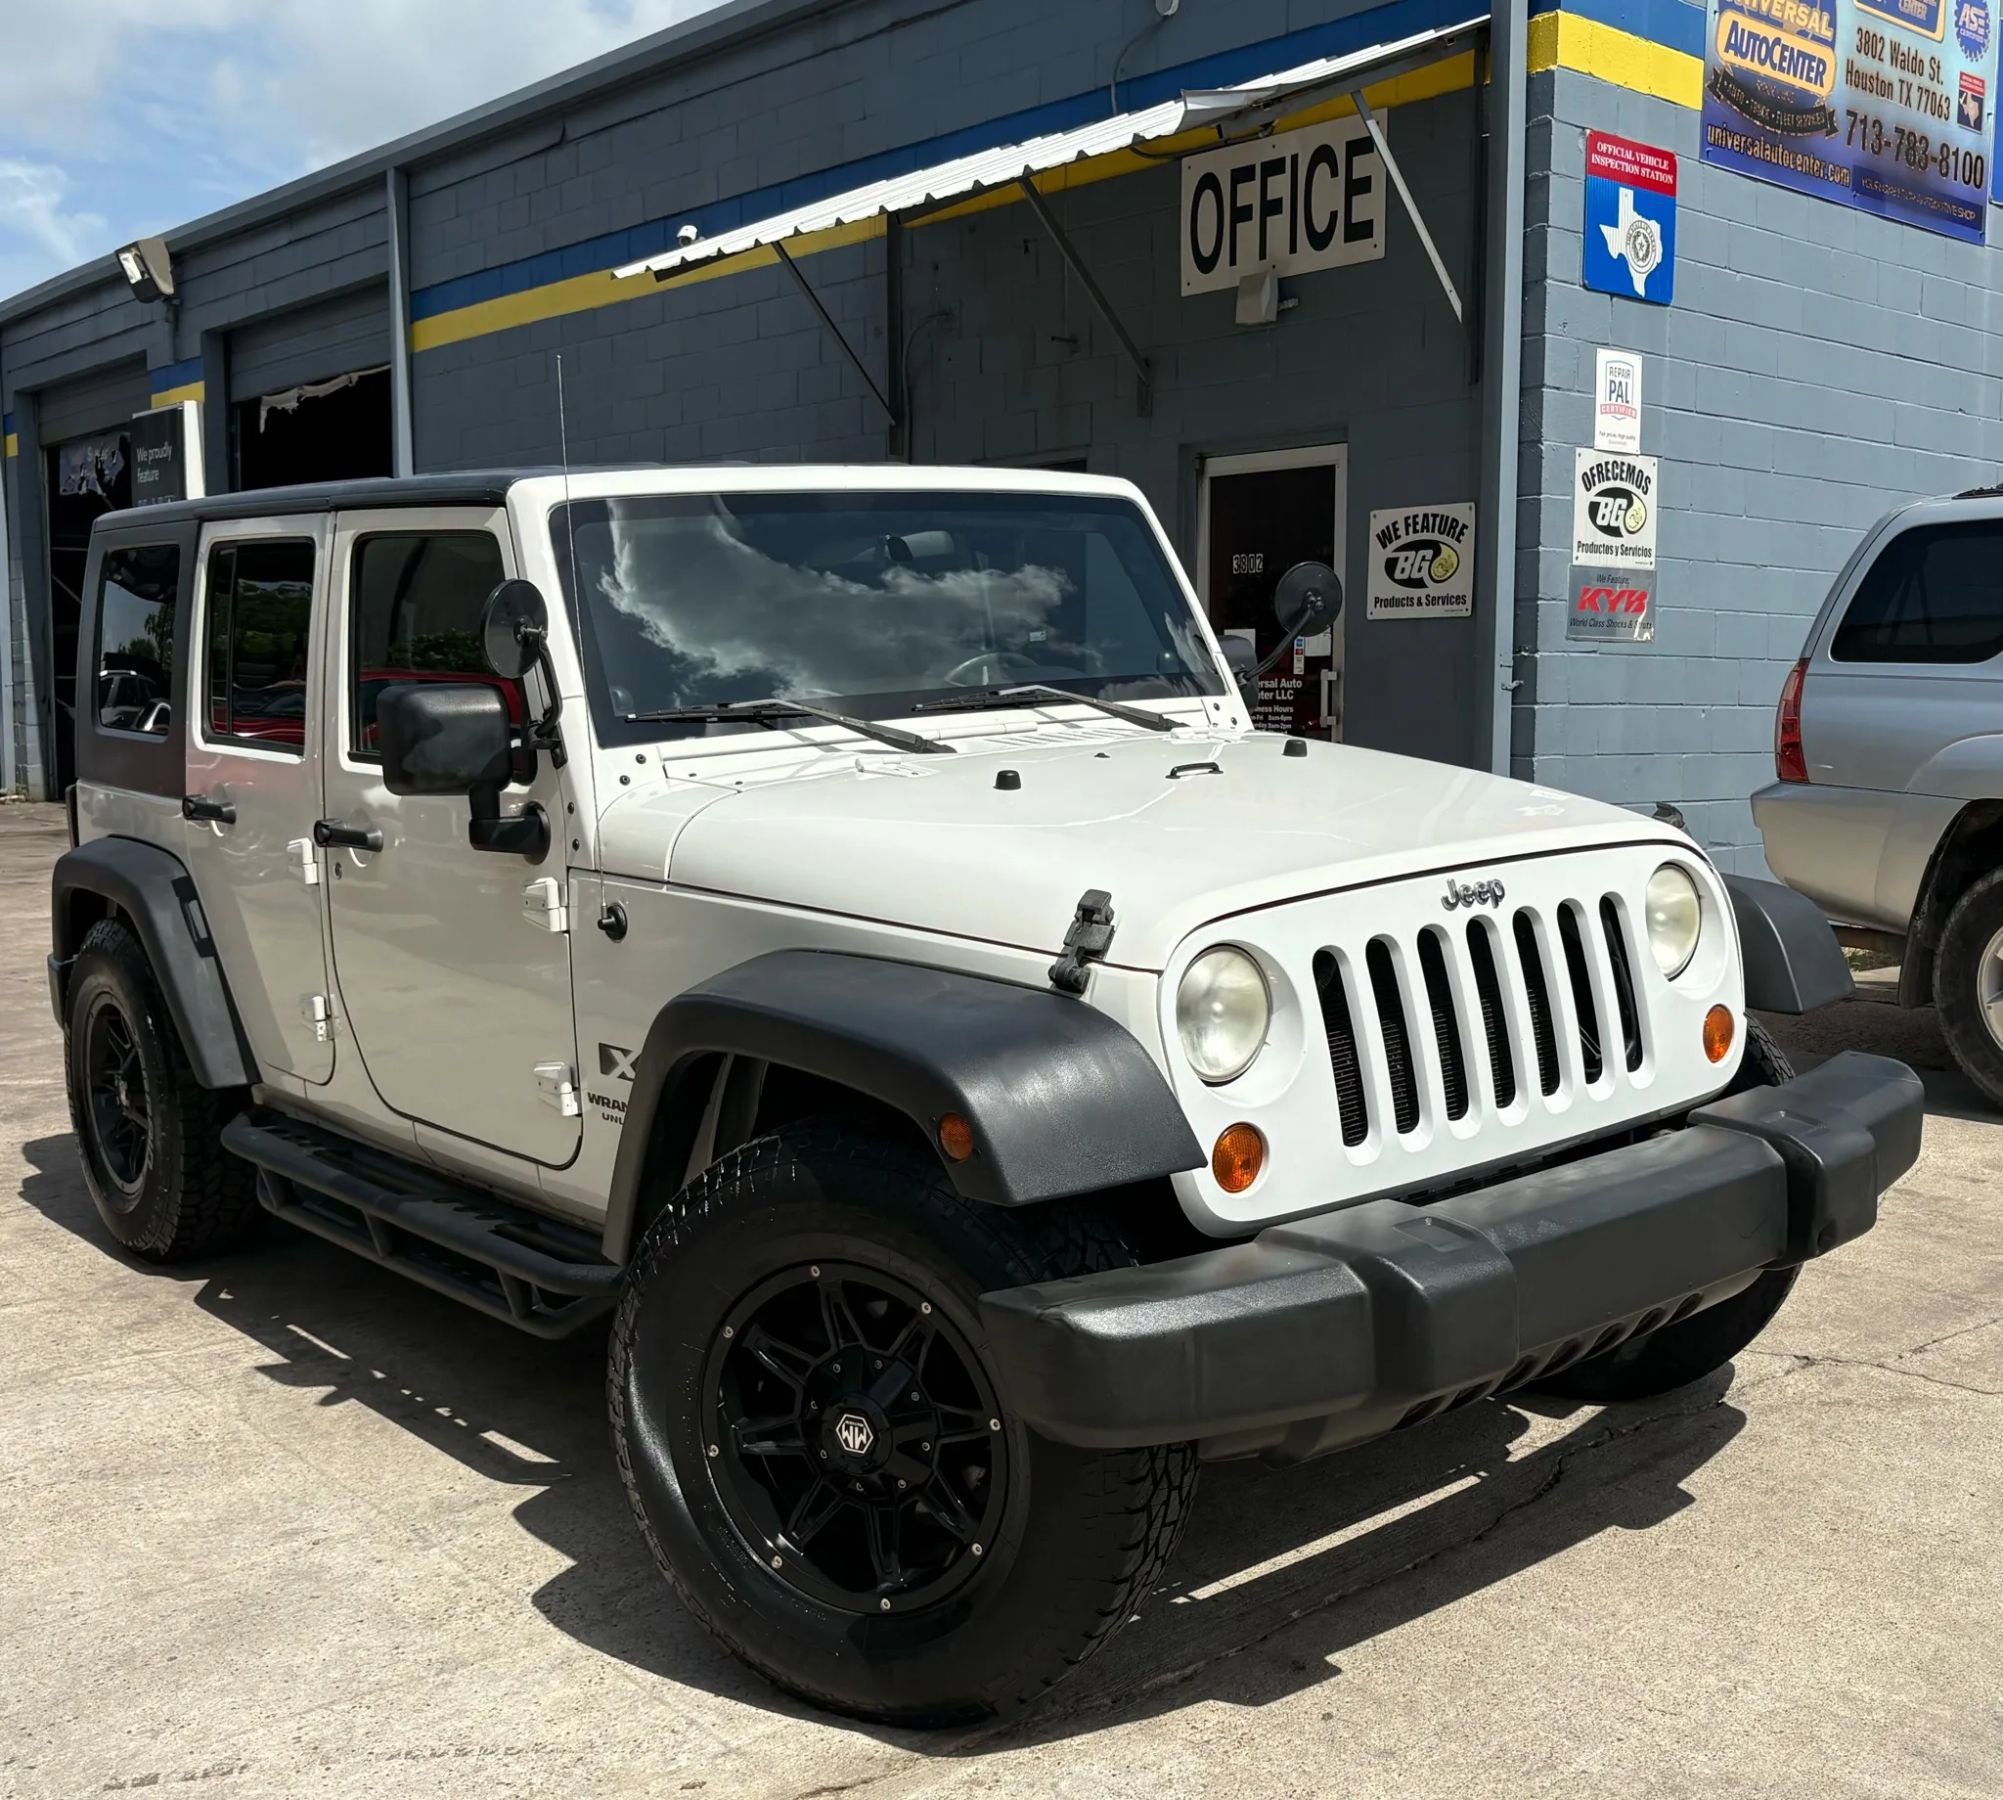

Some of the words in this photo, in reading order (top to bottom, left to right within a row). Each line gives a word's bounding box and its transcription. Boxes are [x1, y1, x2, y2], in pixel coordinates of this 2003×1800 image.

[1734, 0, 1834, 41] IVERSAL
[1959, 3, 1986, 35] ASE
[1724, 20, 1827, 88] AUTOCENTER
[1856, 27, 1885, 62] 3802
[1890, 39, 1924, 77] Waldo
[1929, 56, 1943, 85] St.
[1846, 58, 1893, 101] Houston
[1898, 79, 1913, 109] TX
[1916, 85, 1950, 121] 77063
[1597, 142, 1635, 161] OFFICIAL
[1636, 152, 1669, 171] VEHICLE
[1707, 122, 1850, 187] universalautocenter.com
[1846, 109, 1984, 189] 713-783-8100
[1591, 153, 1640, 176] INSPECTION
[1641, 167, 1674, 185] STATION
[1190, 136, 1375, 275] OFFICE
[1609, 366, 1631, 379] REPAIR
[1609, 379, 1630, 404] PAL
[137, 467, 160, 484] feature
[1582, 460, 1651, 496] OFRECEMOS
[1592, 496, 1629, 528] BG
[1375, 520, 1402, 550] WE
[1403, 512, 1469, 545] FEATURE
[1233, 553, 1264, 574] 3802
[1392, 549, 1434, 580] BG
[1577, 540, 1613, 556] Productos
[1614, 545, 1620, 557] y
[1620, 543, 1652, 559] Servicios
[1374, 595, 1415, 609] Products
[1416, 596, 1423, 607] &
[1425, 593, 1467, 607] Services
[1578, 586, 1649, 613] KYB
[1570, 617, 1588, 628] World
[1588, 618, 1605, 628] Class
[1606, 619, 1627, 629] Shocks
[1276, 690, 1294, 700] LLC
[1280, 678, 1303, 688] Auto
[1273, 705, 1294, 713] Hours
[1441, 878, 1505, 912] Jeep
